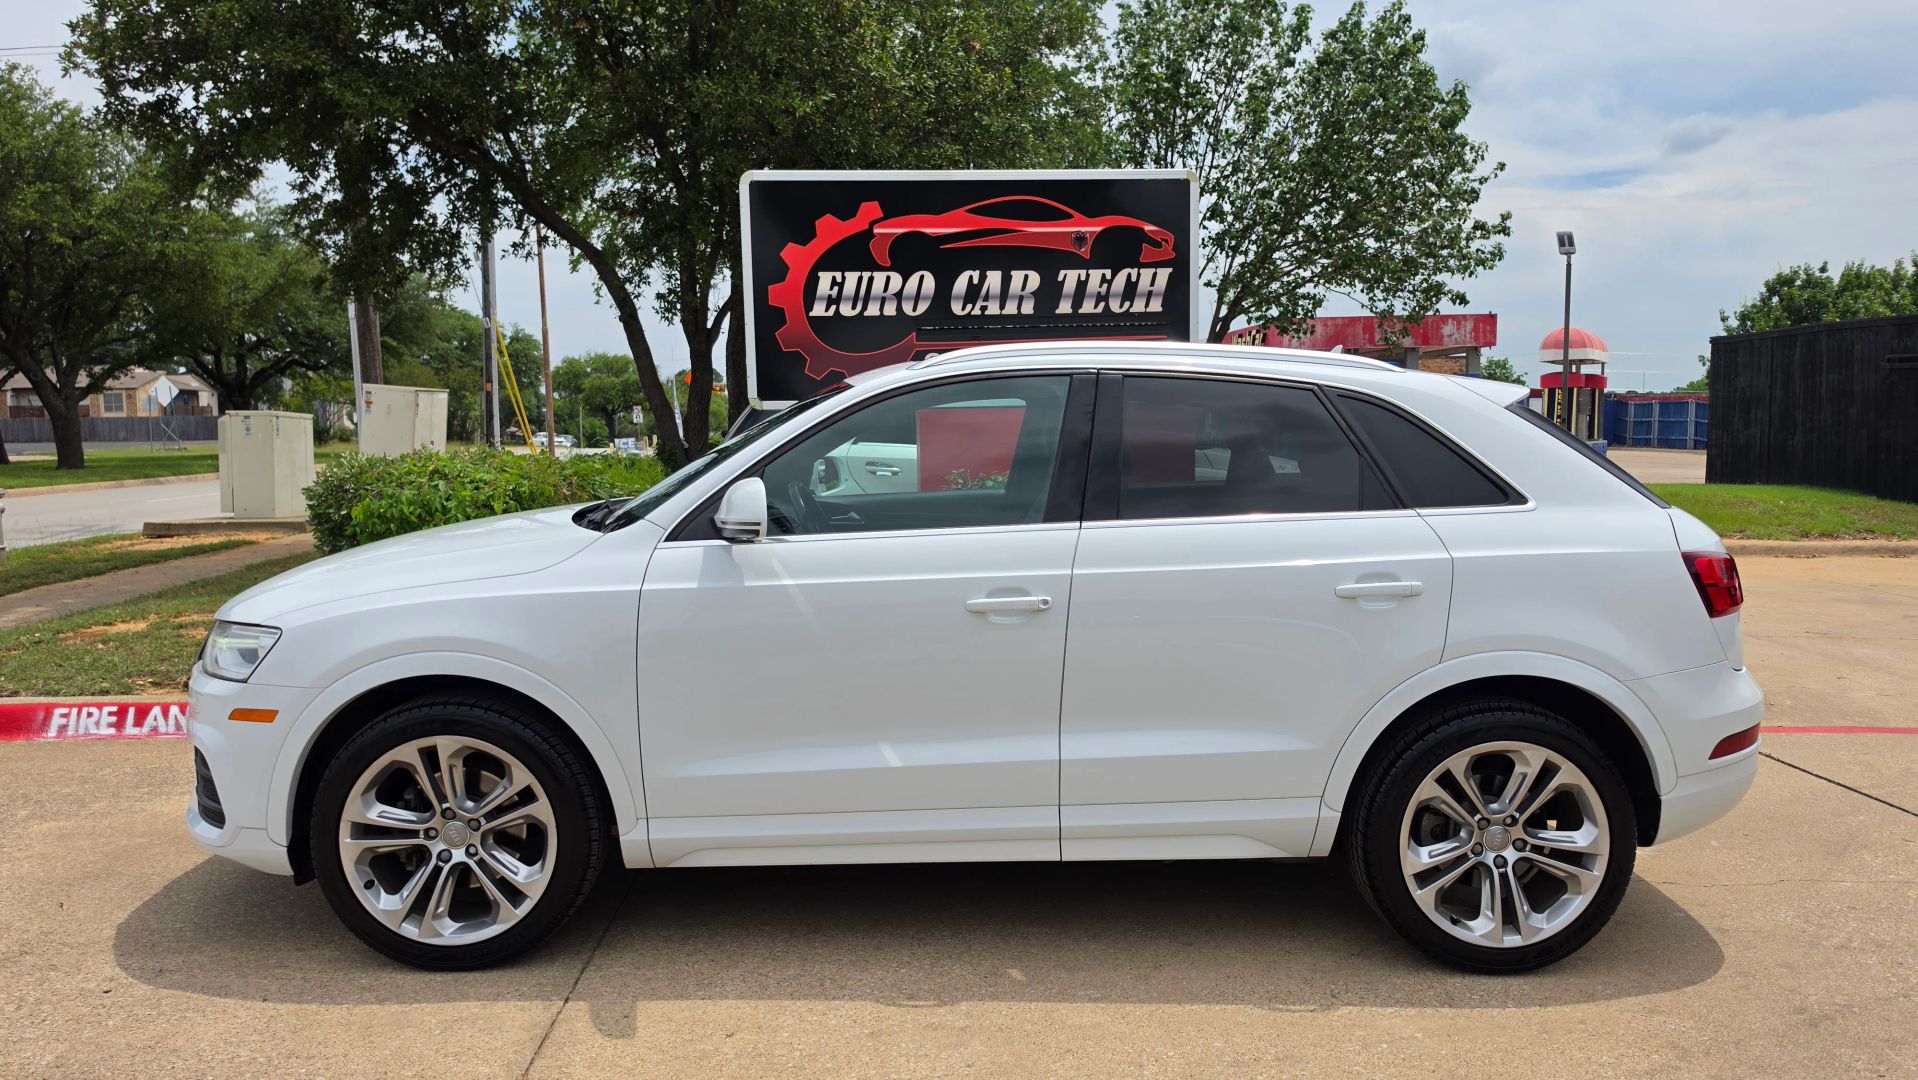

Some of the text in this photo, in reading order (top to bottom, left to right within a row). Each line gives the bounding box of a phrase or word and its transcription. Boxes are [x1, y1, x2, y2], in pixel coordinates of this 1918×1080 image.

[809, 267, 1174, 317] EURO CAR TECH
[48, 706, 118, 737] FIRE
